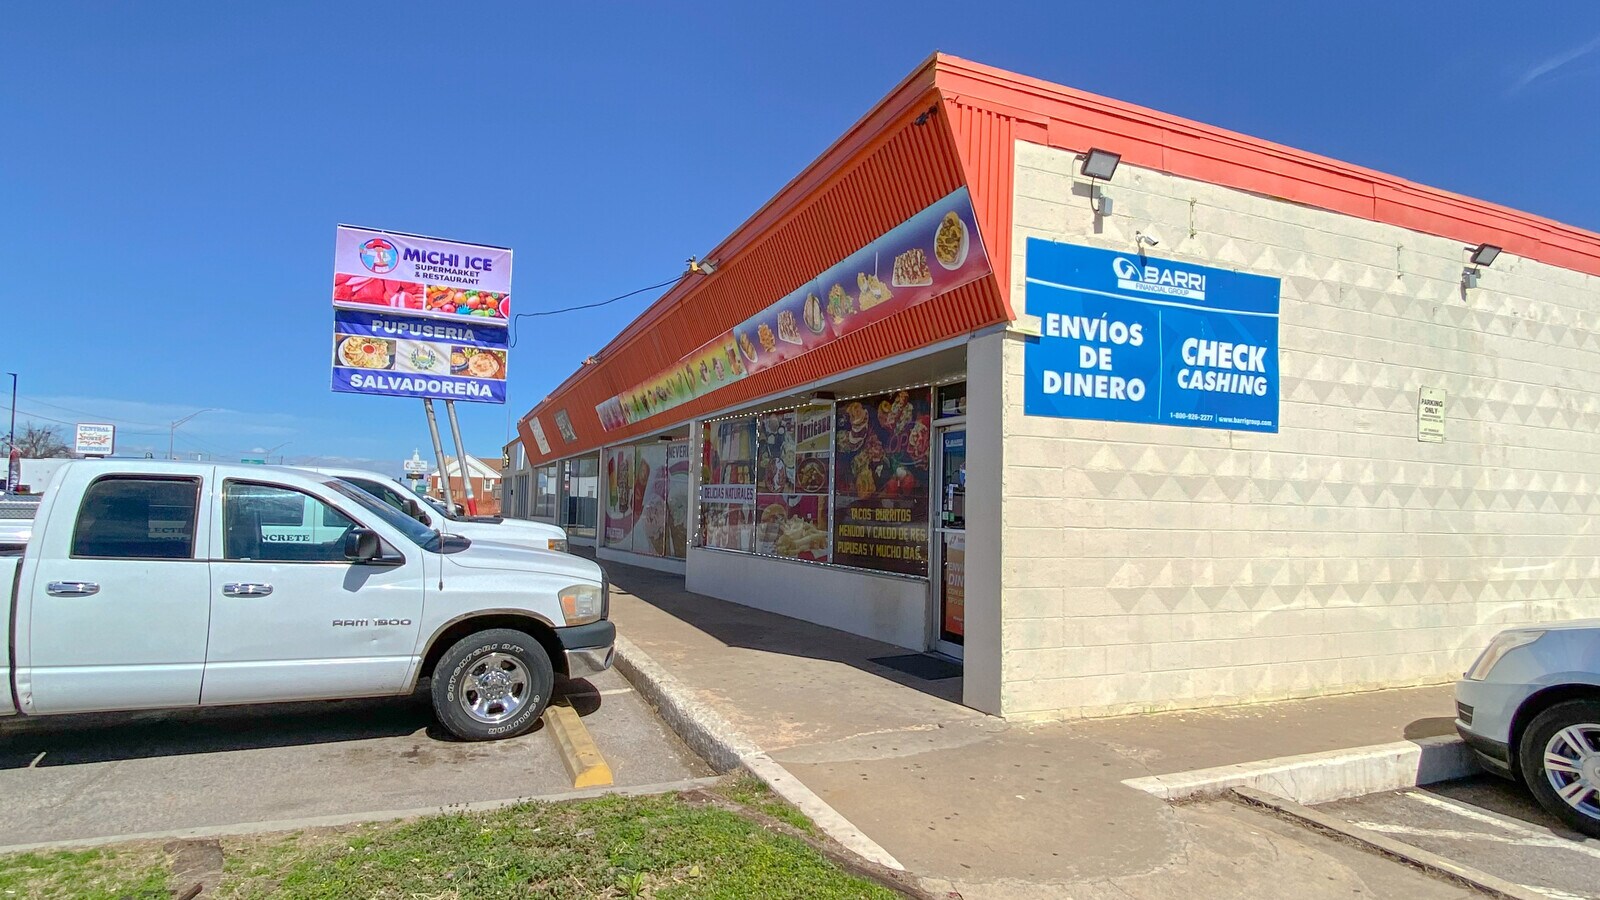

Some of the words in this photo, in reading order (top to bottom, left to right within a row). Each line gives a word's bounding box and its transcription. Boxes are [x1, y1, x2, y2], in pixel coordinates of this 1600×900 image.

[403, 247, 459, 268] MICHI
[464, 256, 493, 272] ICE
[415, 263, 480, 278] SUPERMARKET
[422, 272, 480, 285] RESTAURANT
[1144, 265, 1206, 291] BARRI
[1135, 282, 1167, 294] FINANCIAL
[1168, 287, 1190, 296] GROUP
[371, 319, 476, 342] PUPUSERIA
[1046, 312, 1144, 347] ENVÍOS
[1079, 345, 1113, 371] DE
[1181, 337, 1268, 373] CHECK
[350, 373, 493, 397] SALVADOREÑA
[1043, 370, 1146, 402] DINERO
[1177, 368, 1268, 397] CASHING
[1421, 398, 1443, 407] PARKING
[80, 425, 110, 433] CENTRAL
[1218, 416, 1272, 426] www.barrigroup.com
[704, 487, 725, 499] DELICIAS
[725, 487, 754, 500] NATURALES
[850, 507, 872, 521] TACOS
[875, 508, 912, 522] BURRITOS
[838, 524, 865, 538] MENUDO
[866, 526, 872, 538] Y
[873, 526, 897, 540] CALDO
[898, 527, 909, 541] DE
[910, 528, 926, 541] RES
[837, 541, 868, 556] PUPUSAS
[869, 543, 875, 556] Y
[876, 544, 901, 559] MUCHO
[332, 619, 369, 627] RAM
[373, 618, 412, 626] 1500
